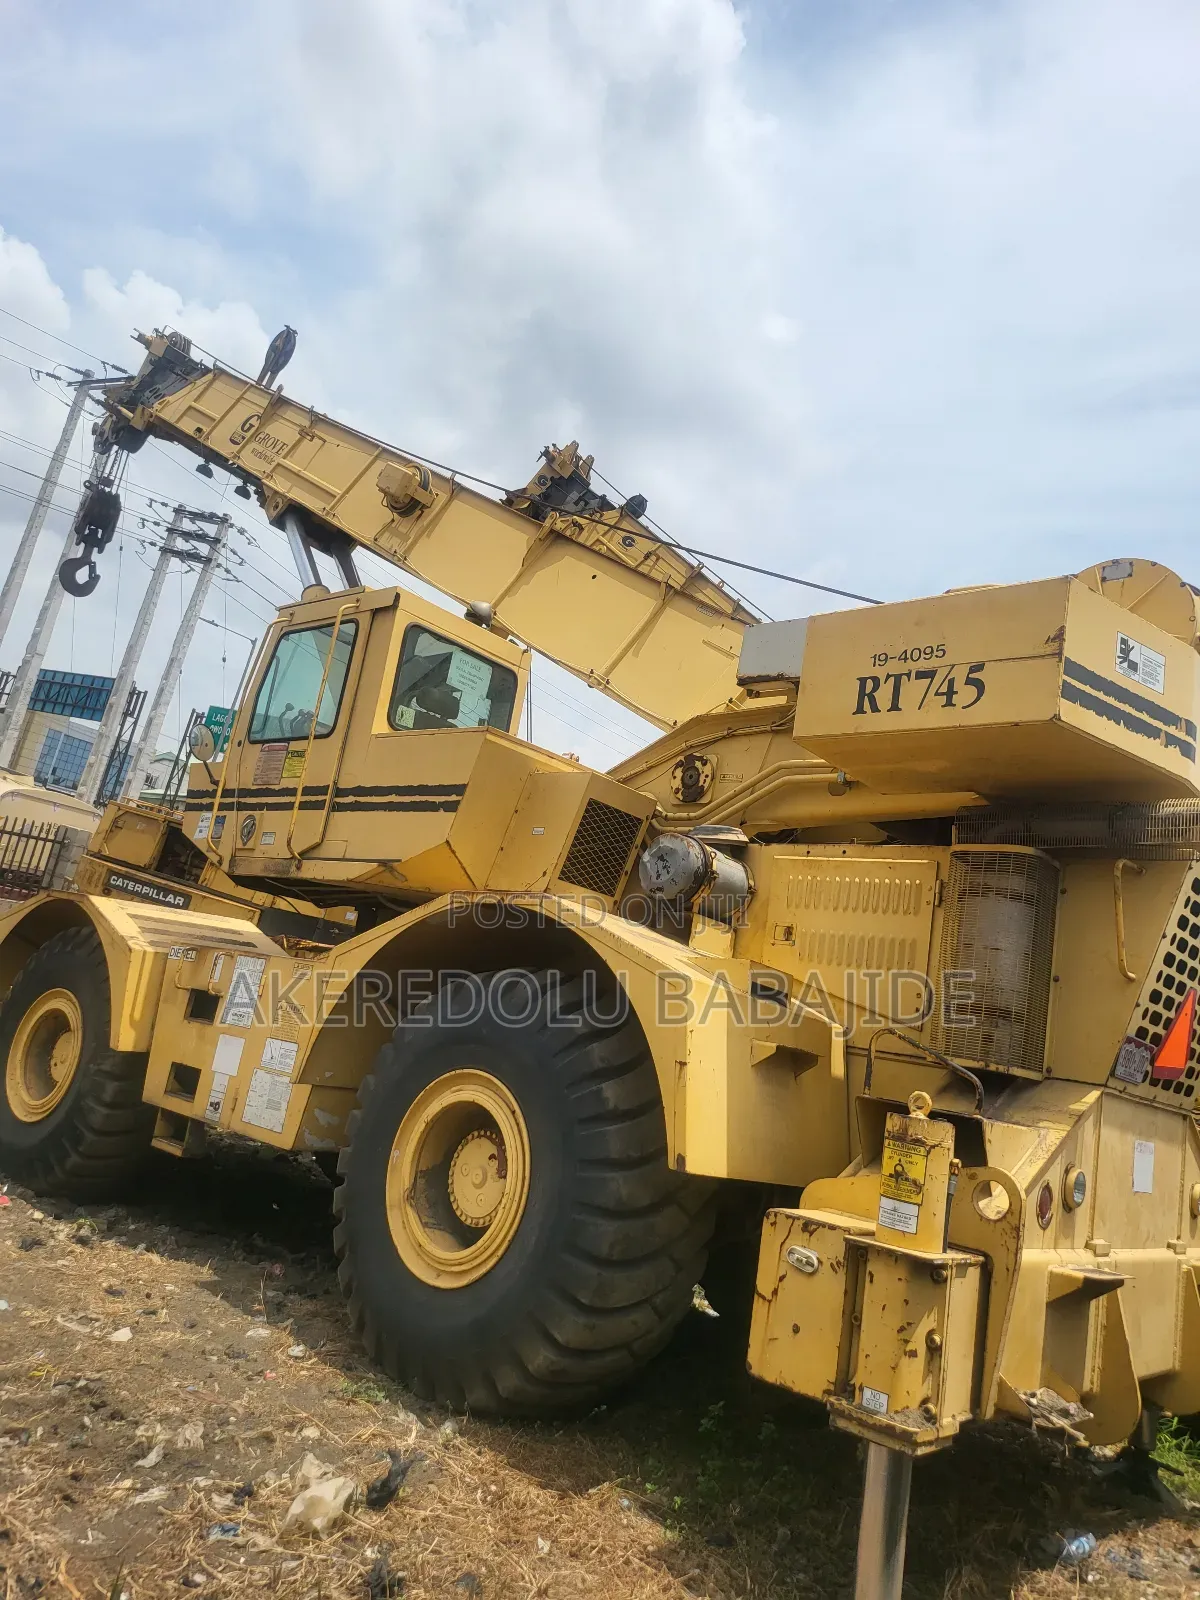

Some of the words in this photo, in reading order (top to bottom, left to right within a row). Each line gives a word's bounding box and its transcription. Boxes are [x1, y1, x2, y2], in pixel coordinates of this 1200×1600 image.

[254, 431, 289, 456] GROVE
[870, 644, 946, 667] 19-4095
[852, 663, 986, 715] RT745
[110, 875, 184, 906] CATERPILLAR
[892, 1141, 921, 1153] WARNING
[866, 1397, 884, 1409] STEP
[870, 1390, 880, 1400] NO
